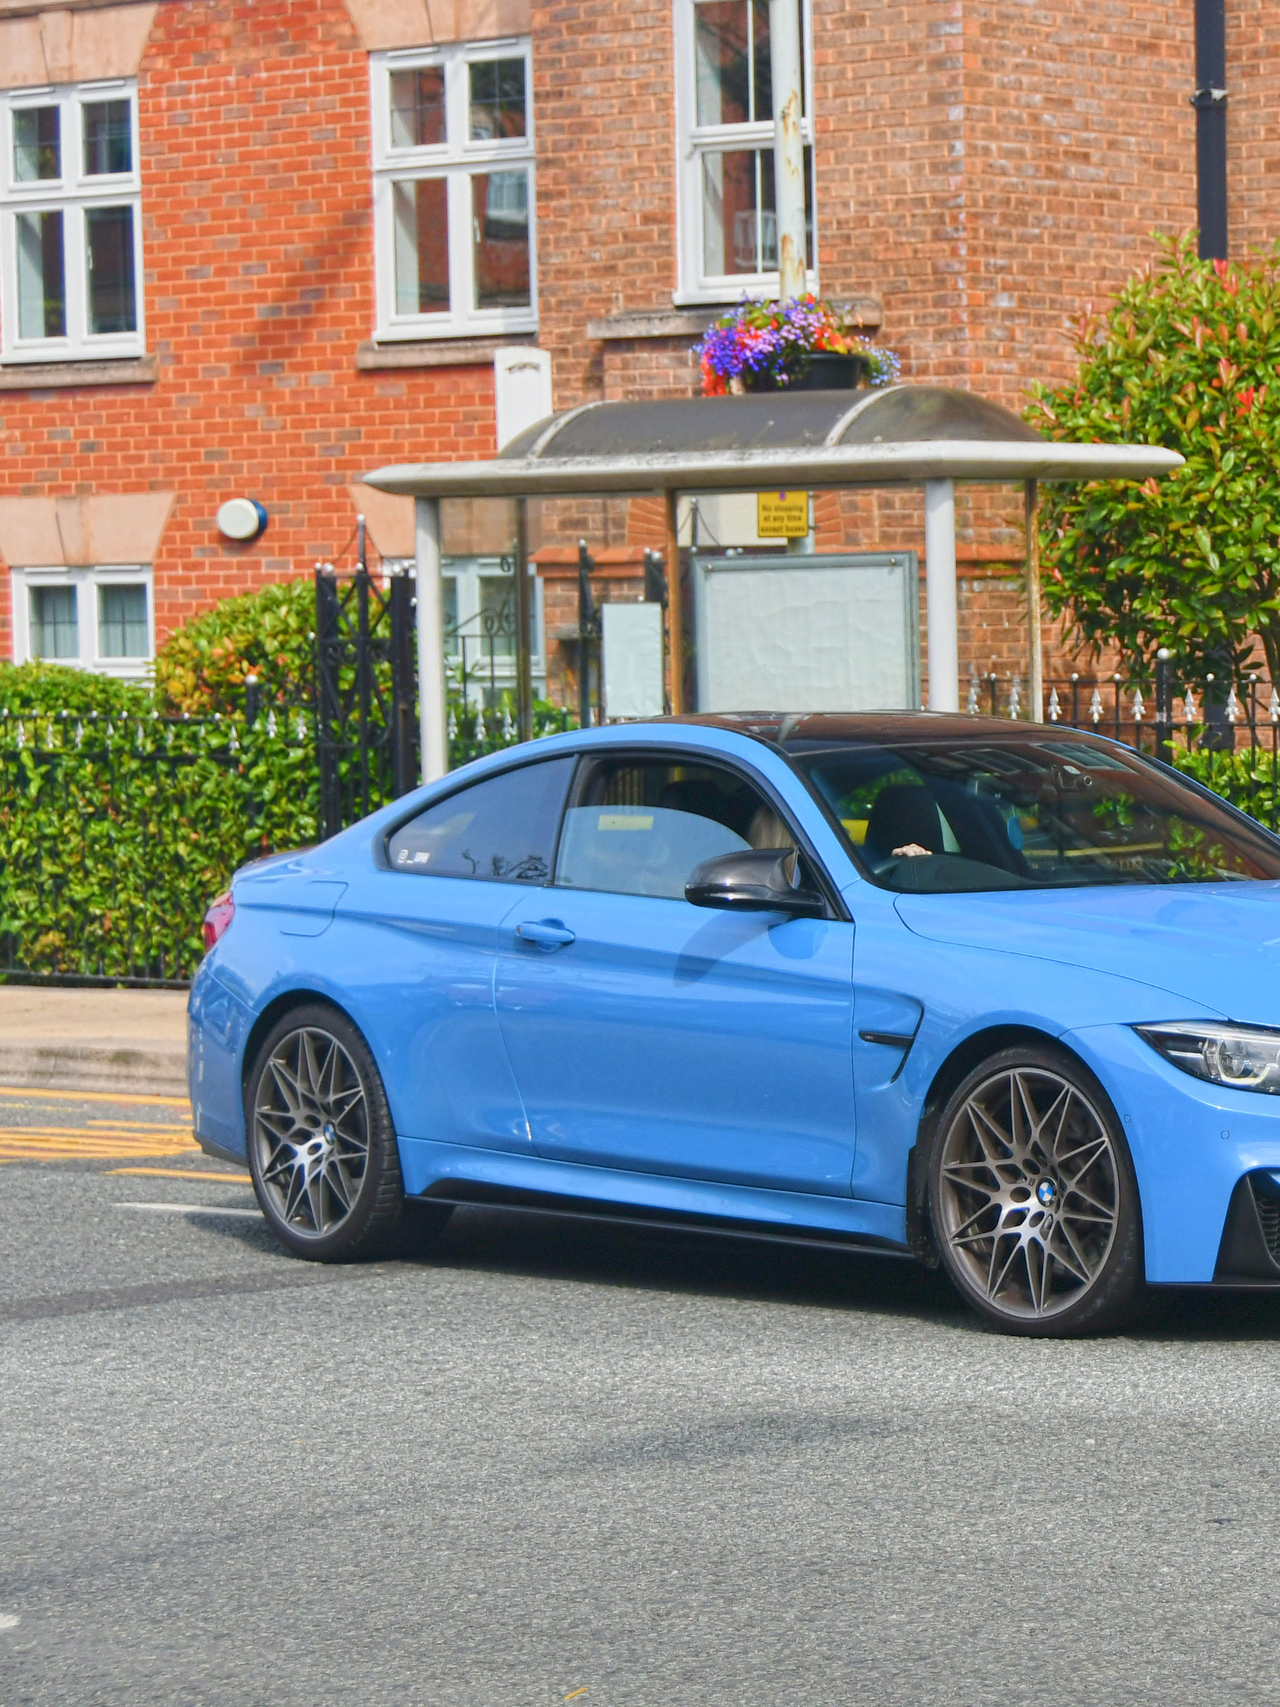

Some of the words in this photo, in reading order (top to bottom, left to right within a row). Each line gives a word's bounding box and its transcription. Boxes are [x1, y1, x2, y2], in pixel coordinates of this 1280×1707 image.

[774, 504, 804, 513] stopping
[773, 515, 784, 523] any
[787, 514, 802, 522] time
